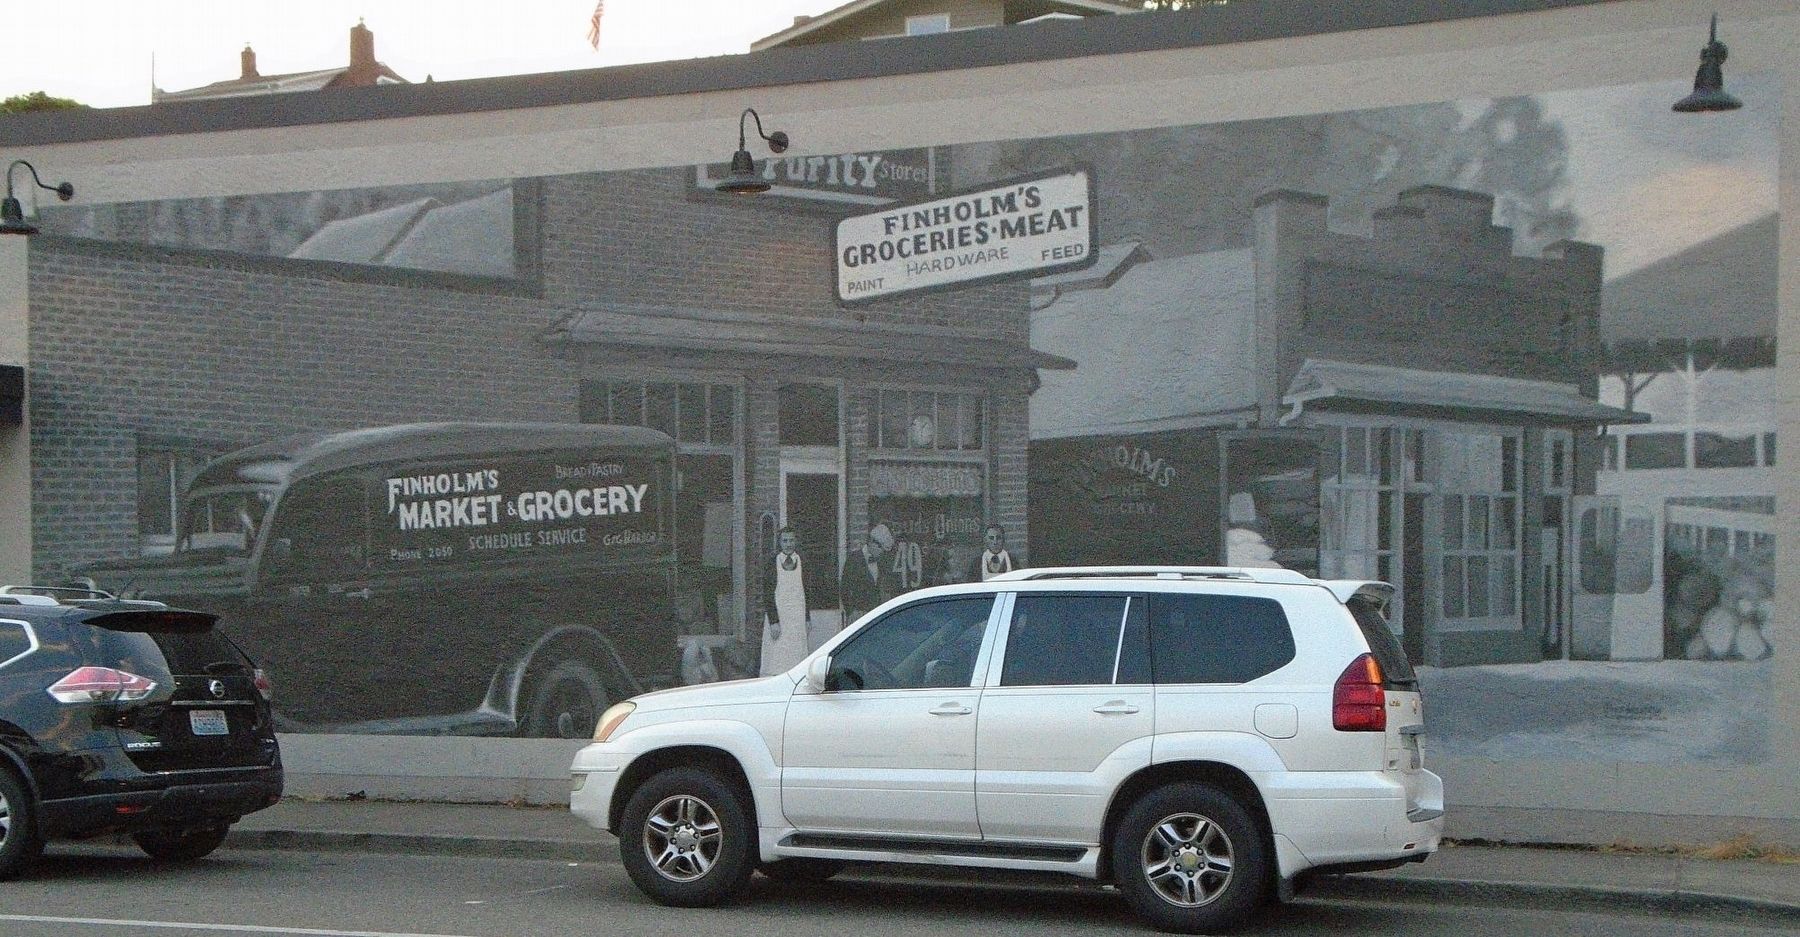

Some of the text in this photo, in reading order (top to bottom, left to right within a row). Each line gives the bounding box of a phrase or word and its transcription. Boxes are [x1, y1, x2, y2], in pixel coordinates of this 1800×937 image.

[883, 185, 1043, 236] FINHOLM'S
[906, 246, 1009, 277] HARDWARE
[1041, 243, 1085, 262] FEED
[847, 278, 885, 295] PAINT
[387, 469, 500, 514] FINHOLM'S
[399, 494, 502, 531] MARKET
[517, 484, 649, 522] GROCERY
[469, 528, 587, 550] SCHEDULE SERVICE
